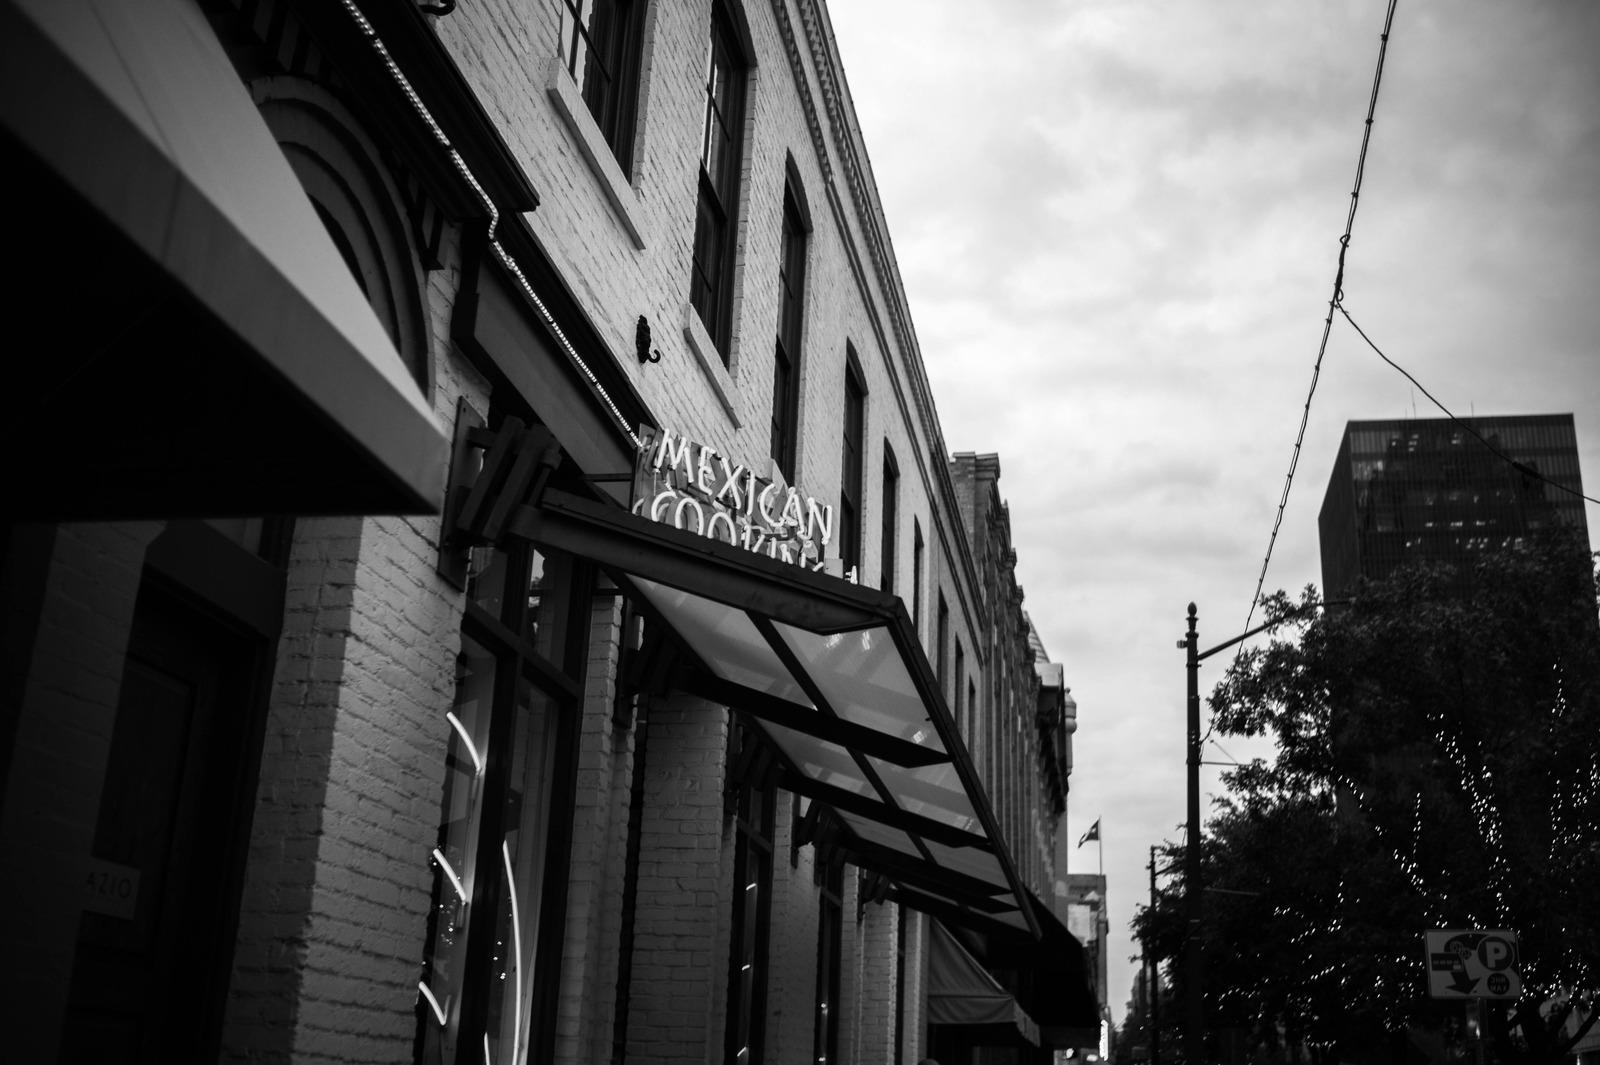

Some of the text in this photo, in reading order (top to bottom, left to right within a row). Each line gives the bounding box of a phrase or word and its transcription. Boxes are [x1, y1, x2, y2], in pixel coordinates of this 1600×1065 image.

[655, 427, 833, 546] MEXICAN
[651, 490, 825, 573] COOK
[84, 871, 132, 898] AZIO
[1485, 941, 1508, 969] P
[1490, 984, 1508, 993] MAX
